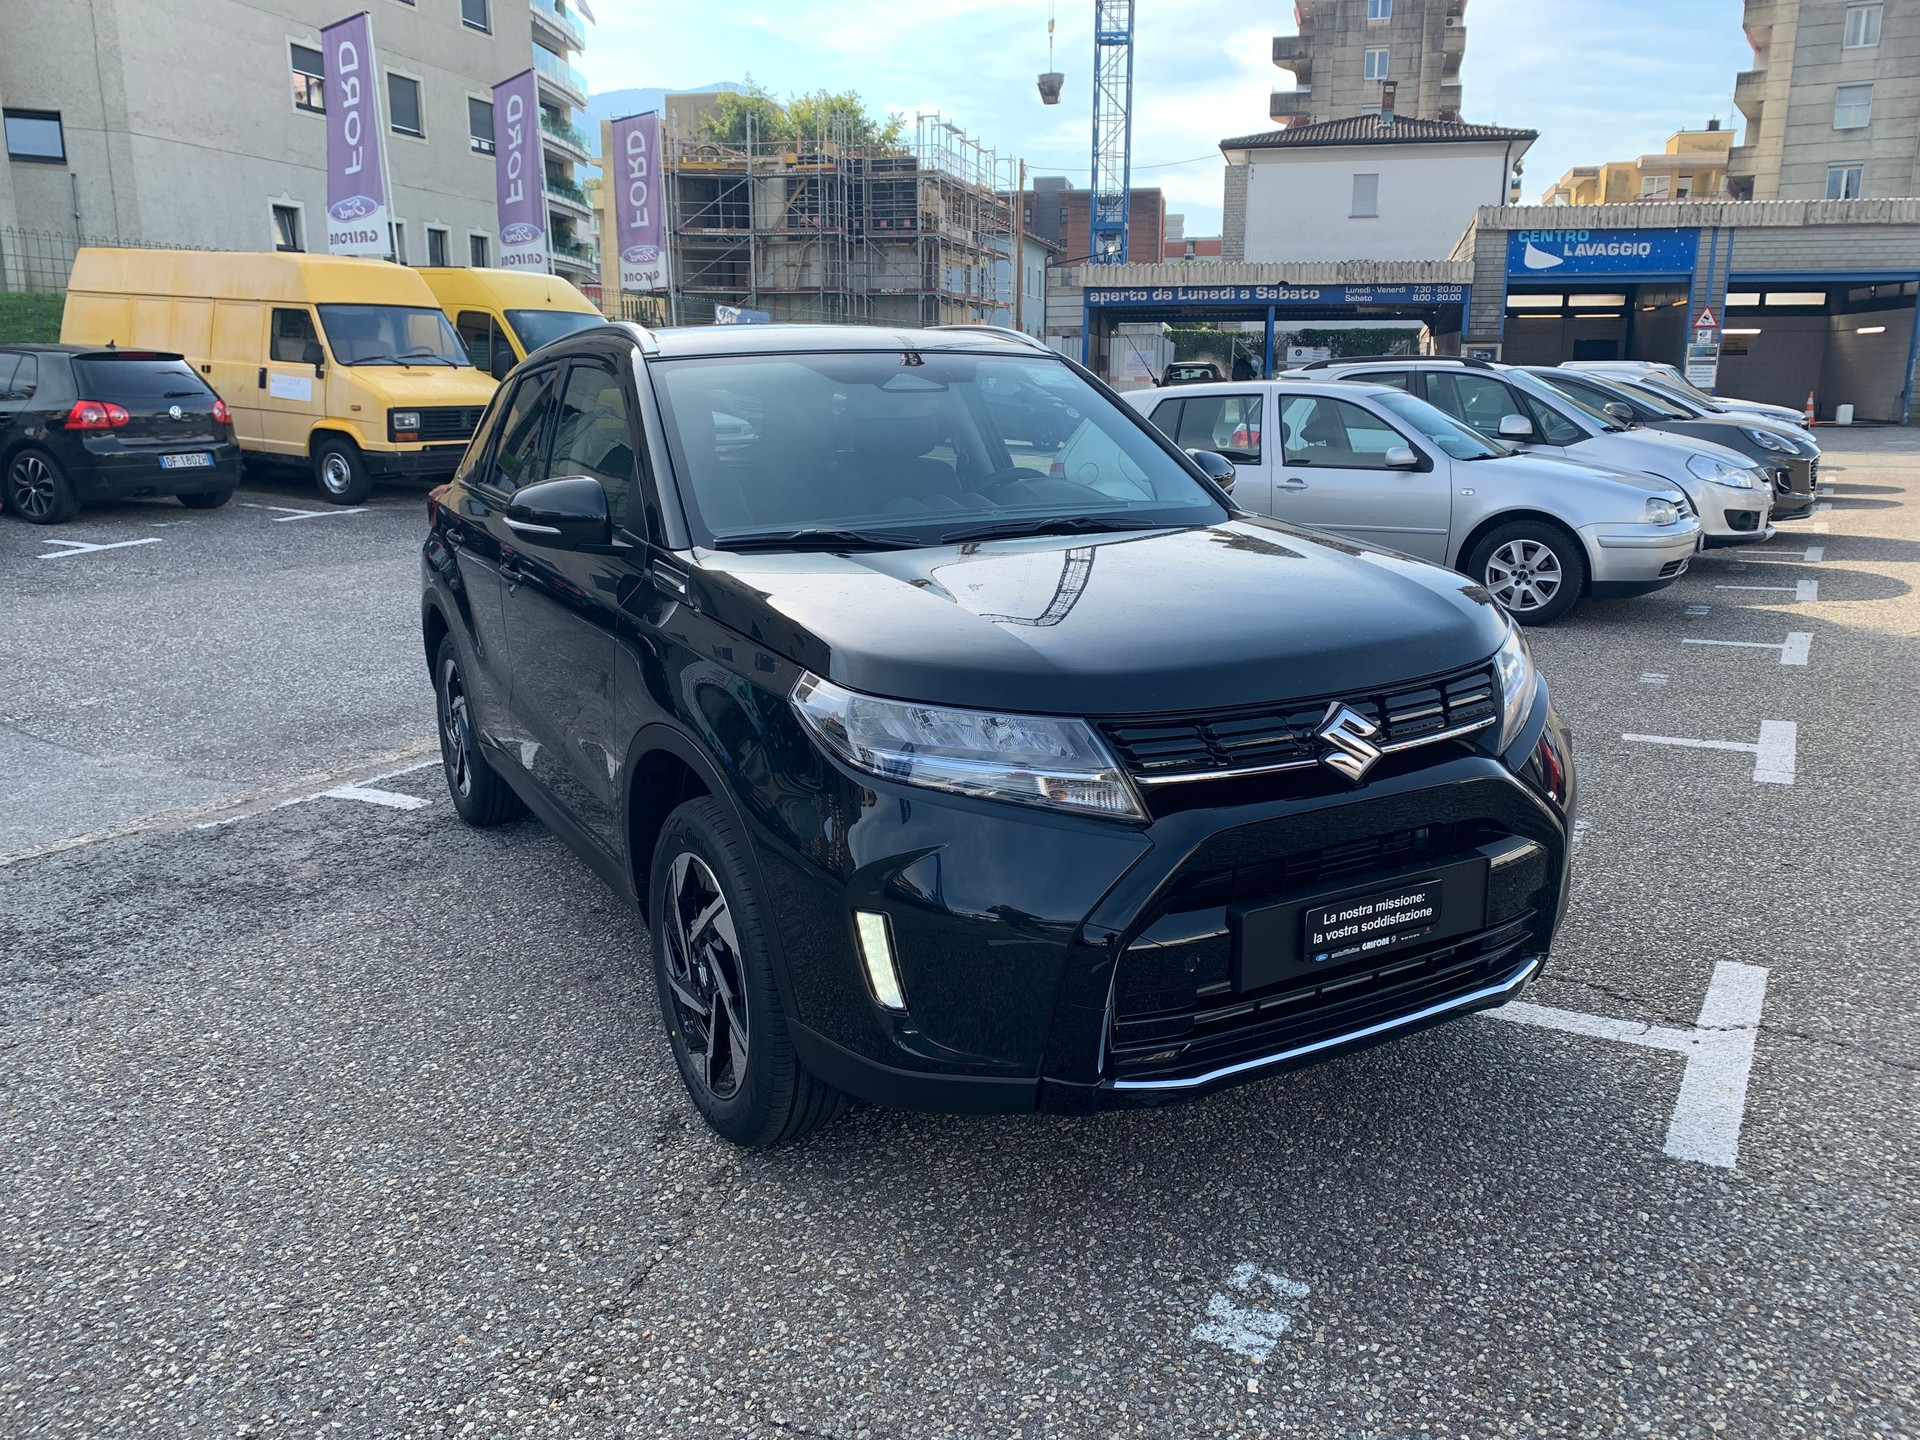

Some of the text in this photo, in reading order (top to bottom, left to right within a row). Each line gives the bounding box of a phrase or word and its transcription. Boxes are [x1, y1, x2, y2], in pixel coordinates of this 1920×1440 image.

[1518, 229, 1590, 243] CENTRO
[1563, 242, 1652, 257] LAVAGGIO
[1089, 286, 1320, 305] aperto da Lunedì a Sabato
[1345, 286, 1371, 294] Lunedì
[1437, 285, 1462, 293] 20.00
[1345, 294, 1373, 302] Sabato
[1436, 293, 1462, 301] 20.00
[1323, 892, 1426, 925] La nostra missione:
[1313, 906, 1433, 945] la vostra soddisfazione
